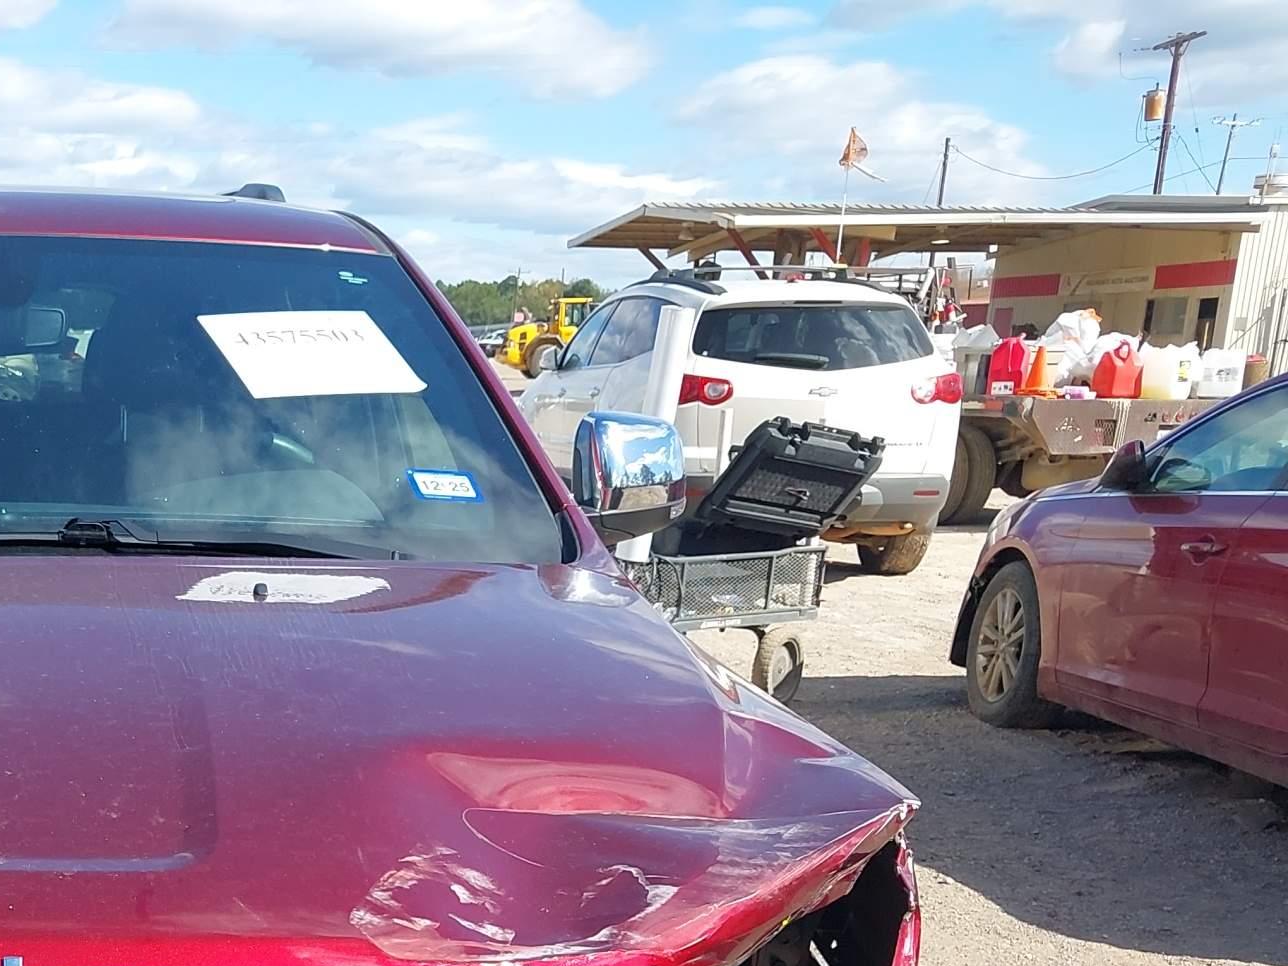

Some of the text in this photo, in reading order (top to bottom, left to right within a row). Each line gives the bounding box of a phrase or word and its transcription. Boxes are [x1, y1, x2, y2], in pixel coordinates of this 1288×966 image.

[234, 328, 365, 345] 43575503
[422, 480, 470, 492] 12 25
